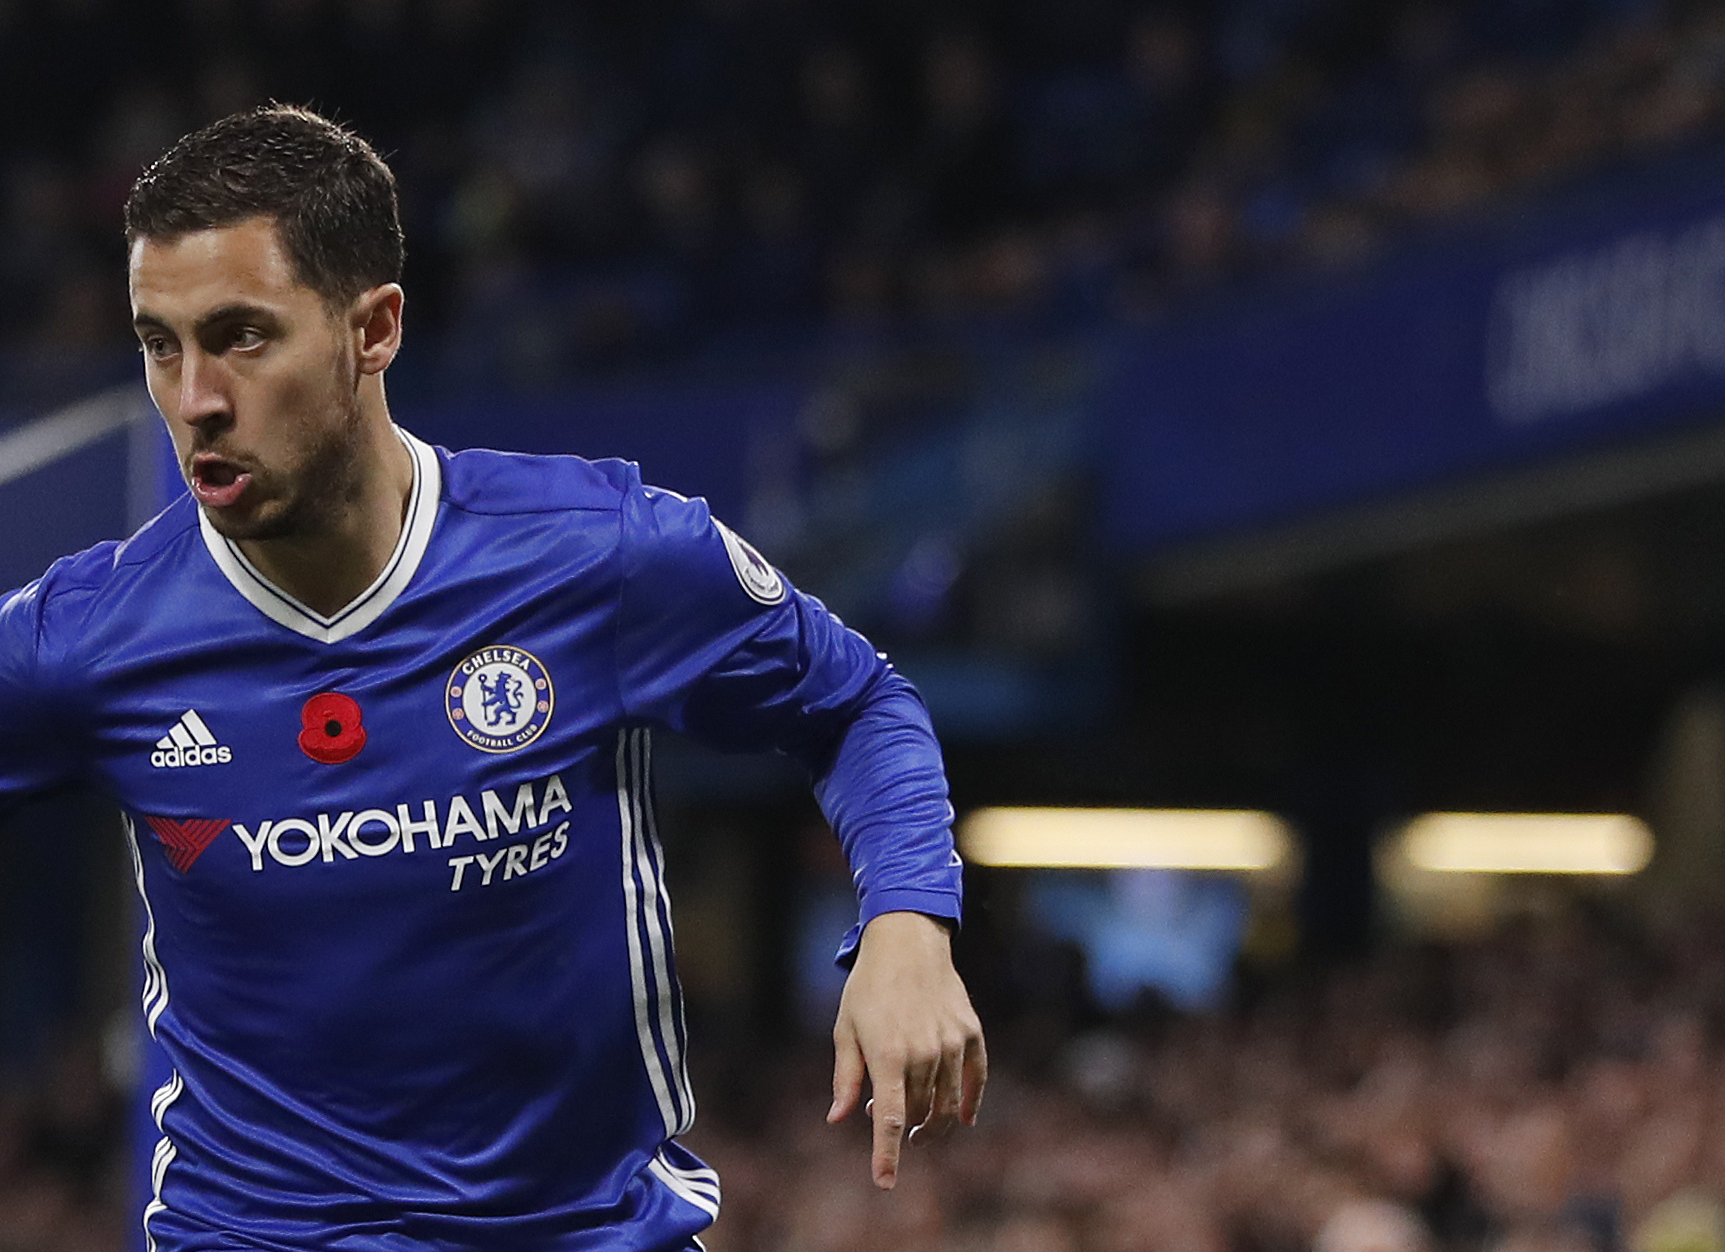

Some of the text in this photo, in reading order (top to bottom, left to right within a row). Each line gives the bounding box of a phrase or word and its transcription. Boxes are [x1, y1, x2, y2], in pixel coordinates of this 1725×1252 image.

[461, 649, 531, 675] CHELSEA
[466, 723, 538, 747] FOOTBALL CLUB
[150, 744, 233, 768] adidas
[231, 774, 572, 871] YOKOHAMA
[448, 820, 571, 892] TYRES
